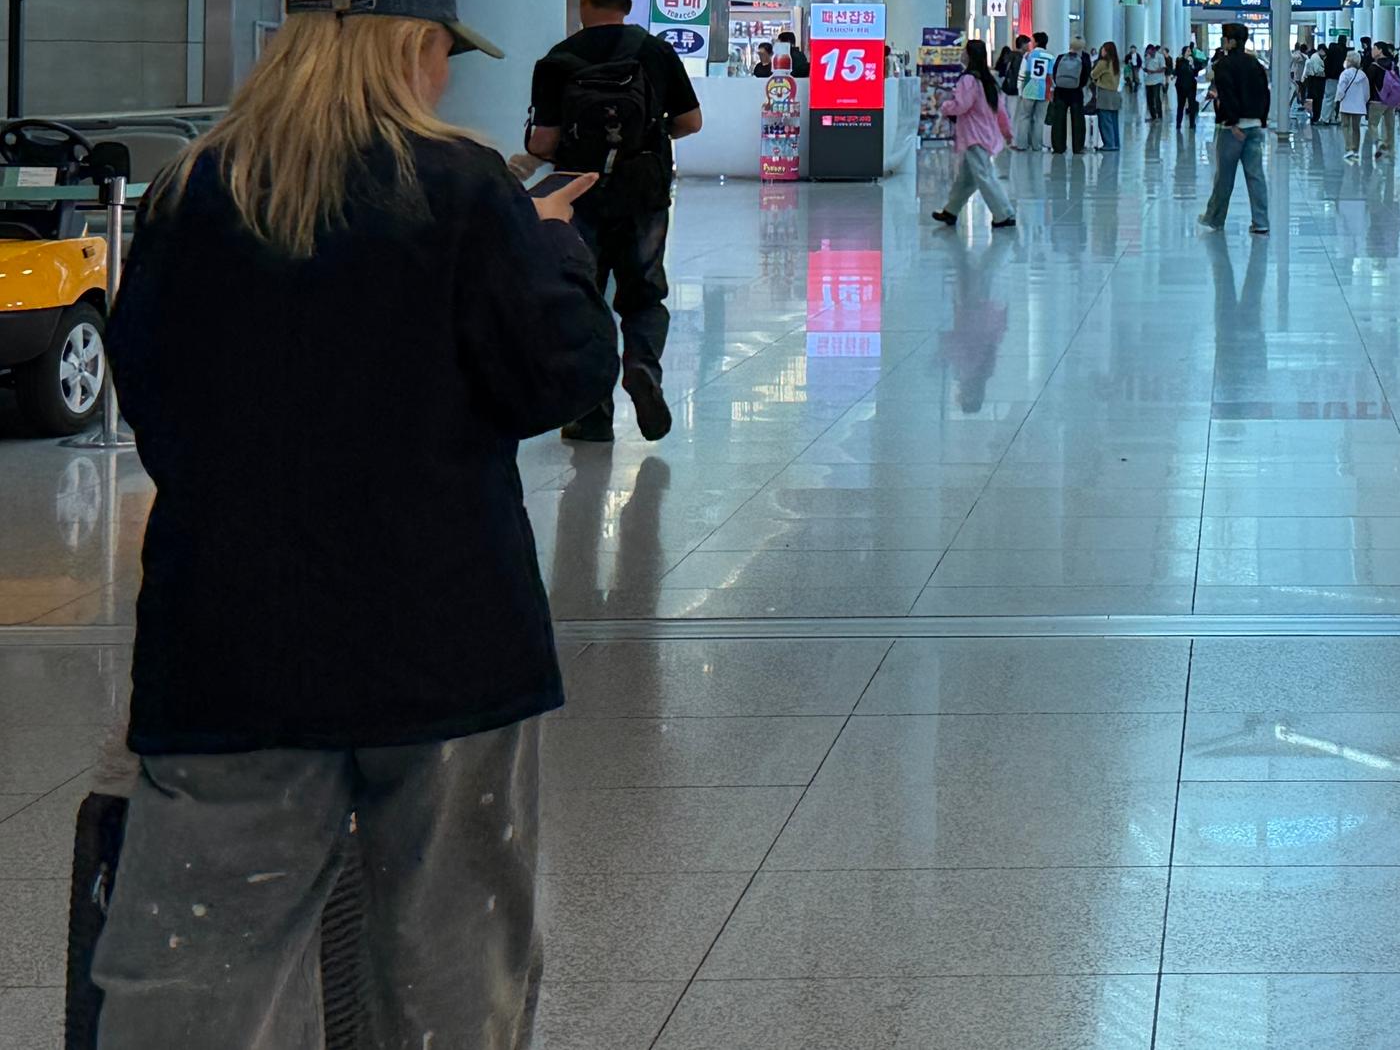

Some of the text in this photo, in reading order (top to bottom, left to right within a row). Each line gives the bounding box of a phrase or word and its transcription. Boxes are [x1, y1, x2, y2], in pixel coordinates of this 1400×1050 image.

[666, 9, 697, 20] TOBACCO
[822, 11, 876, 25] 패션잡화
[664, 31, 696, 49] 주류
